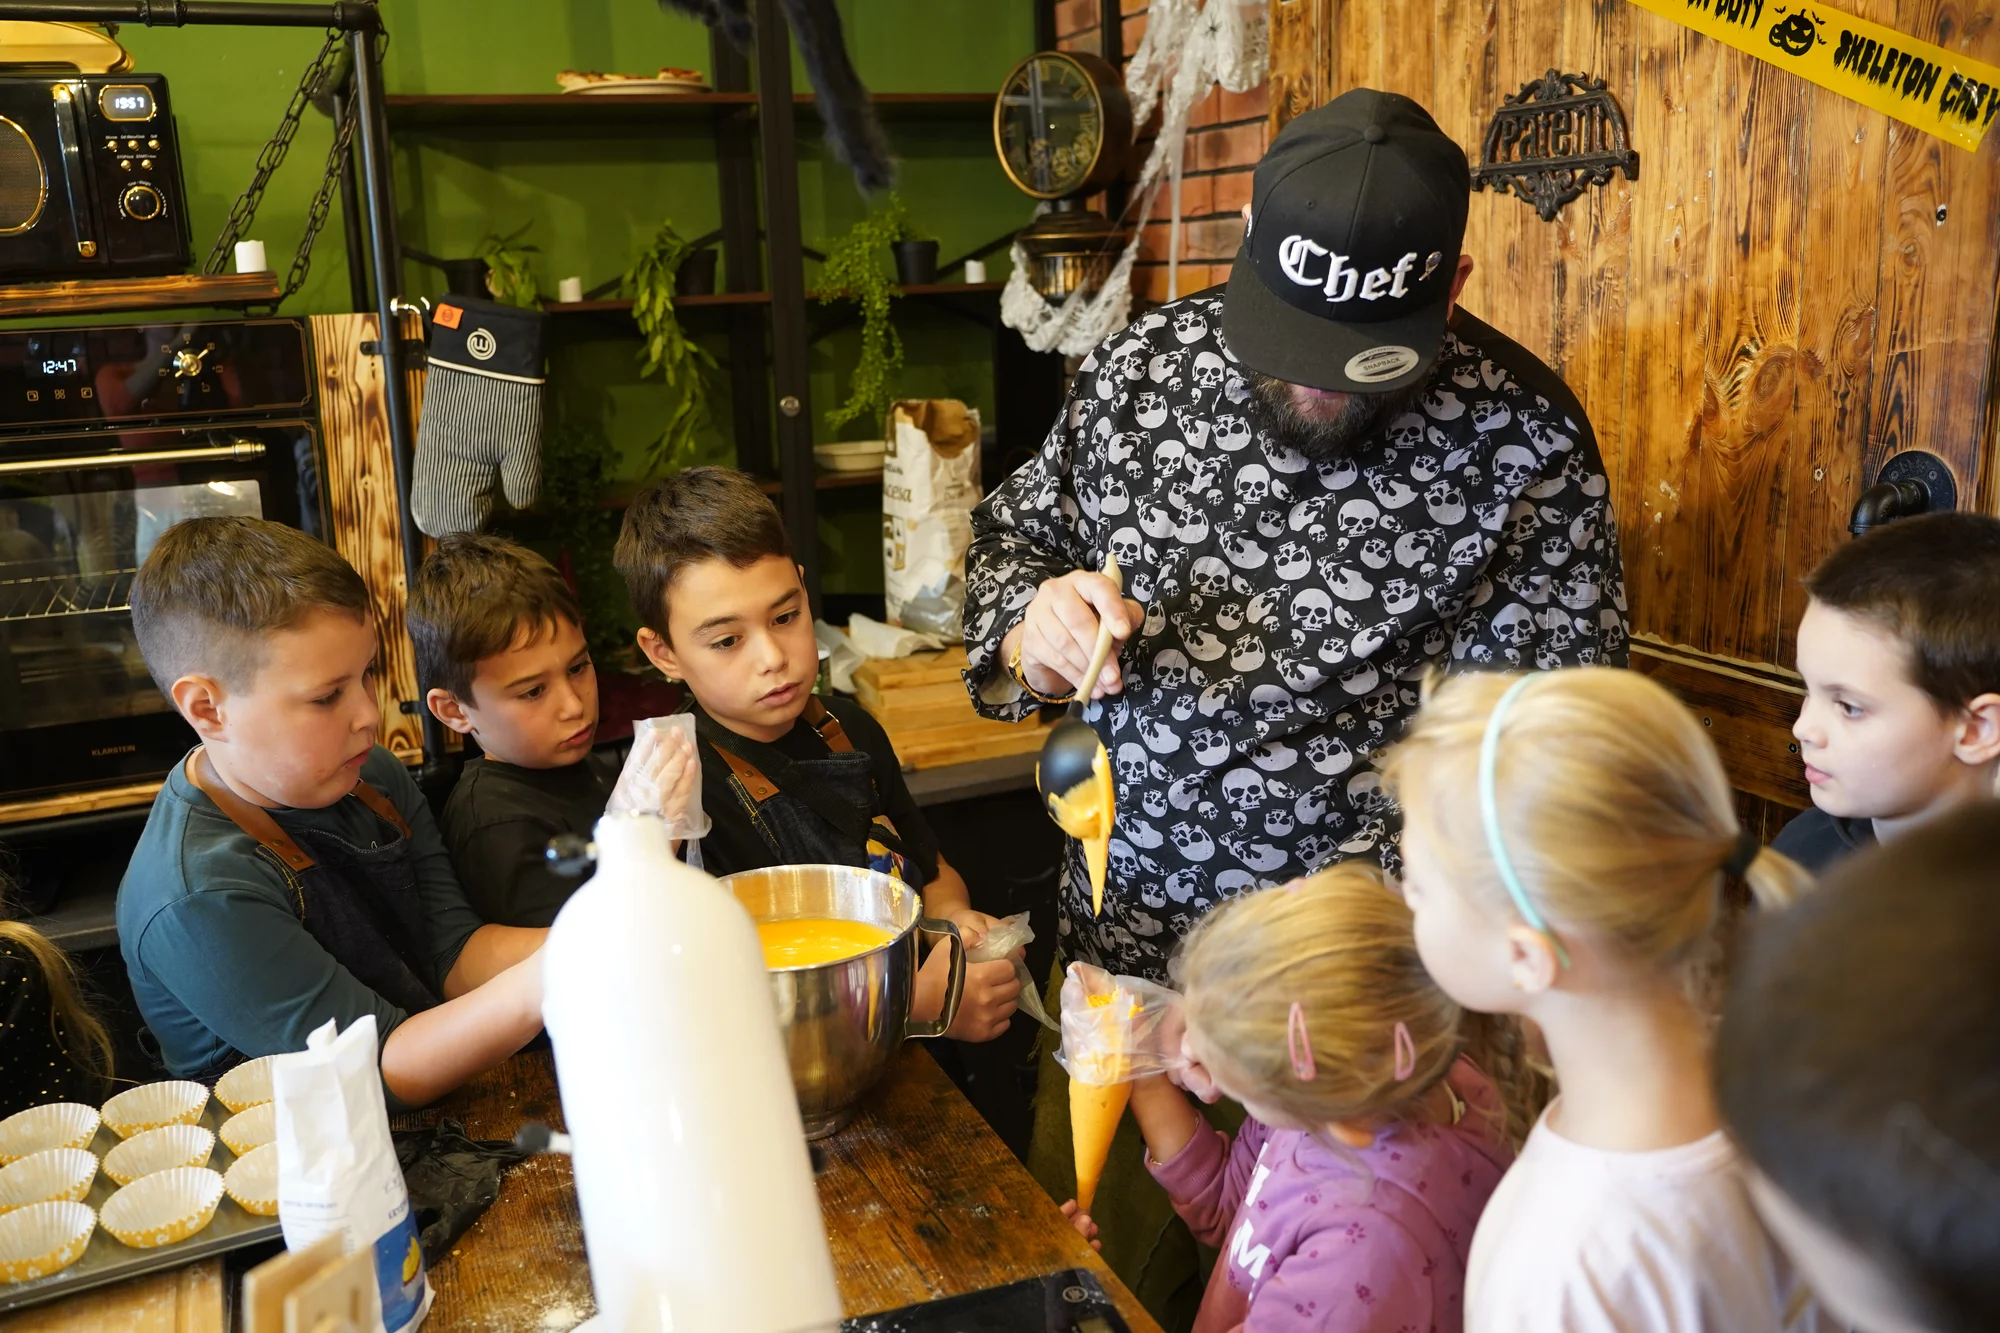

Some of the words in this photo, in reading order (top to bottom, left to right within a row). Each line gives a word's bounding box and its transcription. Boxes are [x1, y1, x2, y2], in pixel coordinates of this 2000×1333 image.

[1834, 30, 1942, 104] SKELETON
[1278, 234, 1418, 302] Chef
[42, 359, 77, 374] 12:47
[1363, 357, 1401, 371] SNAPBACK
[91, 745, 136, 756] KLARSTEIN
